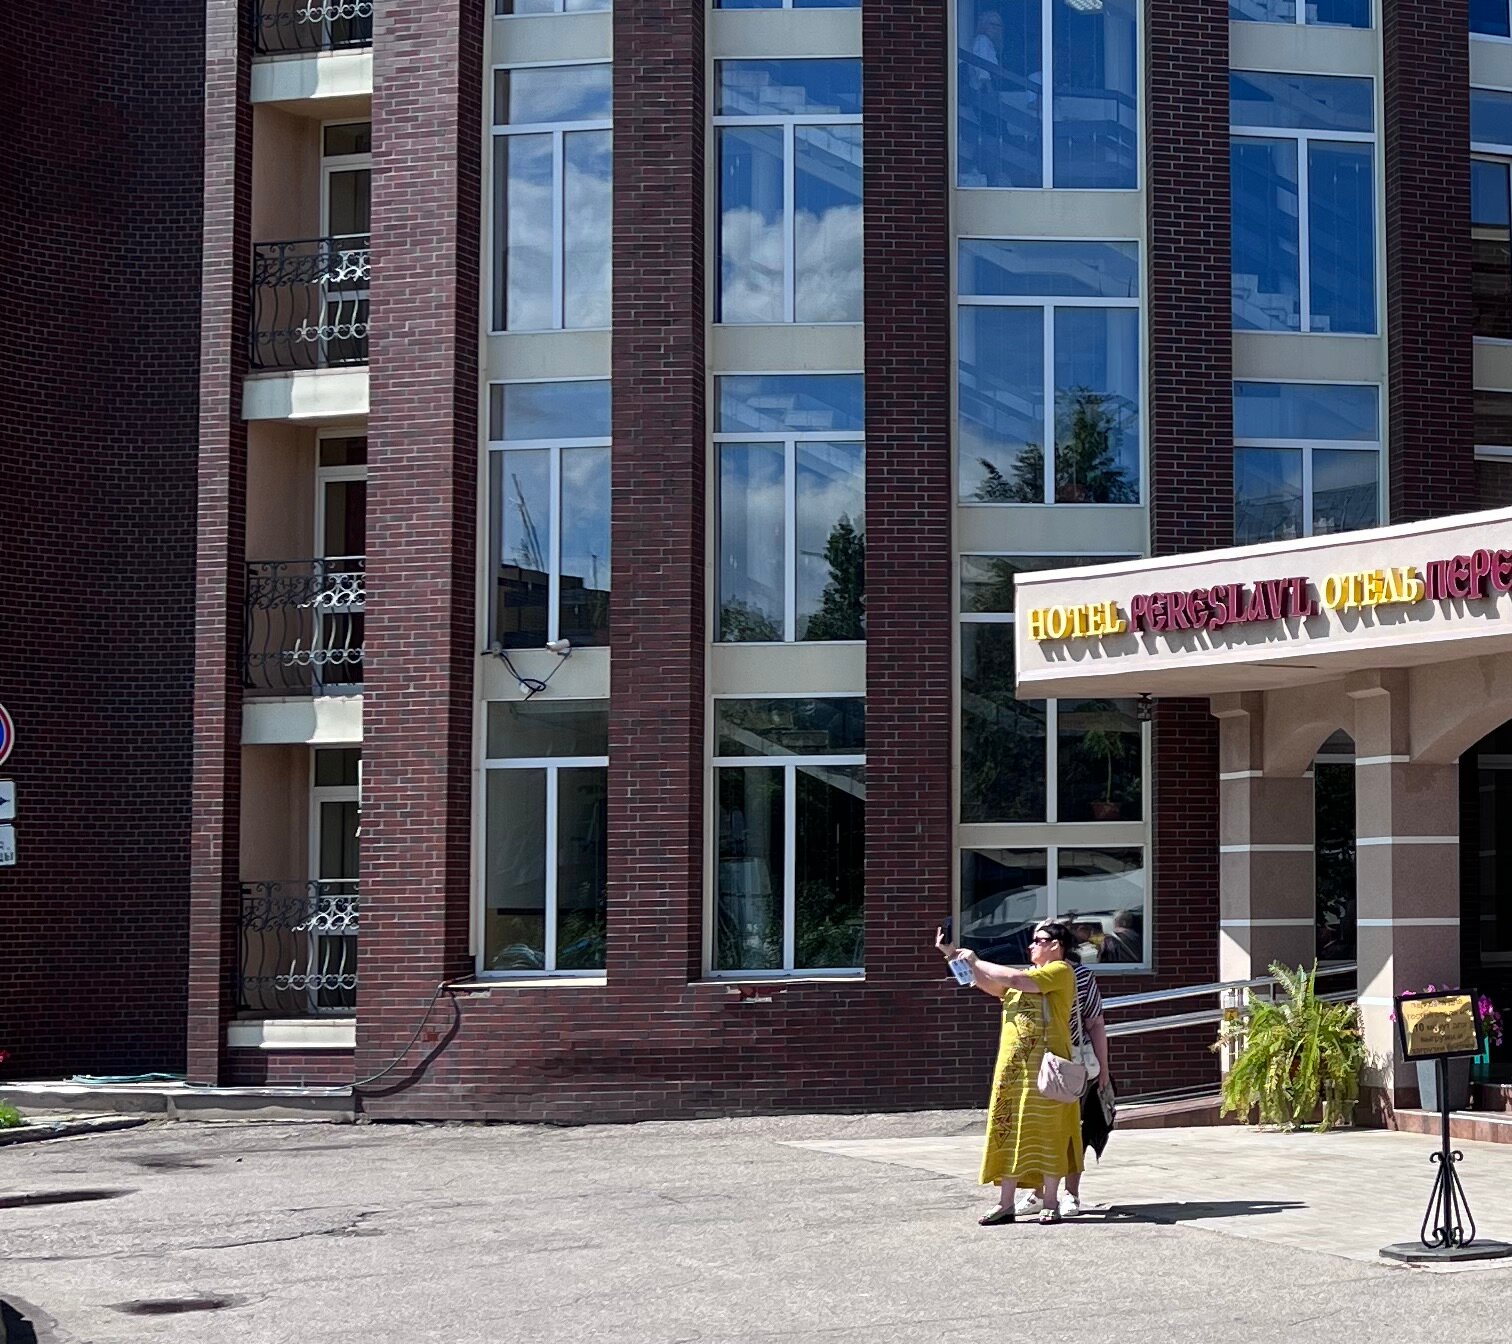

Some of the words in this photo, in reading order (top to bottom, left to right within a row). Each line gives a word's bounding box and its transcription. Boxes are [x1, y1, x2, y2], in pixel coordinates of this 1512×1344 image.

[1026, 600, 1128, 641] HOTEL
[1127, 576, 1320, 633] PERESLAVL
[1320, 566, 1426, 610] ОТЕЛЬ
